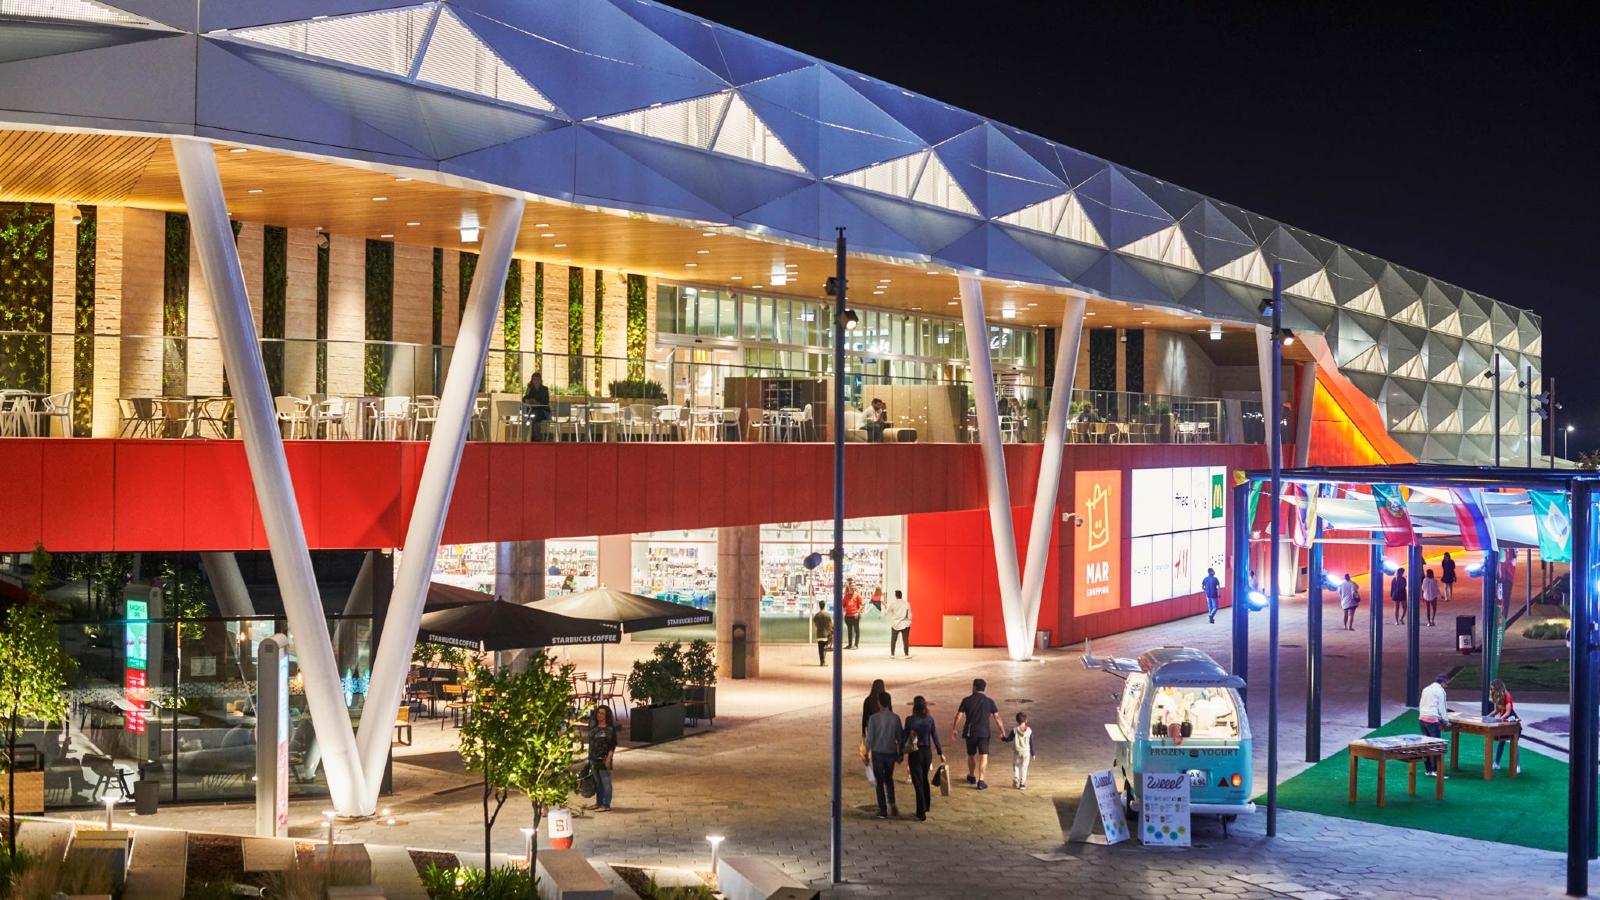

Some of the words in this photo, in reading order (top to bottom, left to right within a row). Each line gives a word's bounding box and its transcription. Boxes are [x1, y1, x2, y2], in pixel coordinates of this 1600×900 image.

[1086, 560, 1110, 584] MAR
[1086, 587, 1110, 597] SHOPPING
[666, 617, 693, 626] STARBUCKS
[693, 615, 710, 623] COFFEE
[428, 633, 459, 646] STARBUCKS
[458, 638, 479, 649] COFFEE
[551, 635, 591, 644] STARBUCKS
[591, 634, 617, 642] COFFEE
[1150, 748, 1185, 756] FROZEN
[1201, 748, 1240, 756] YOGURT
